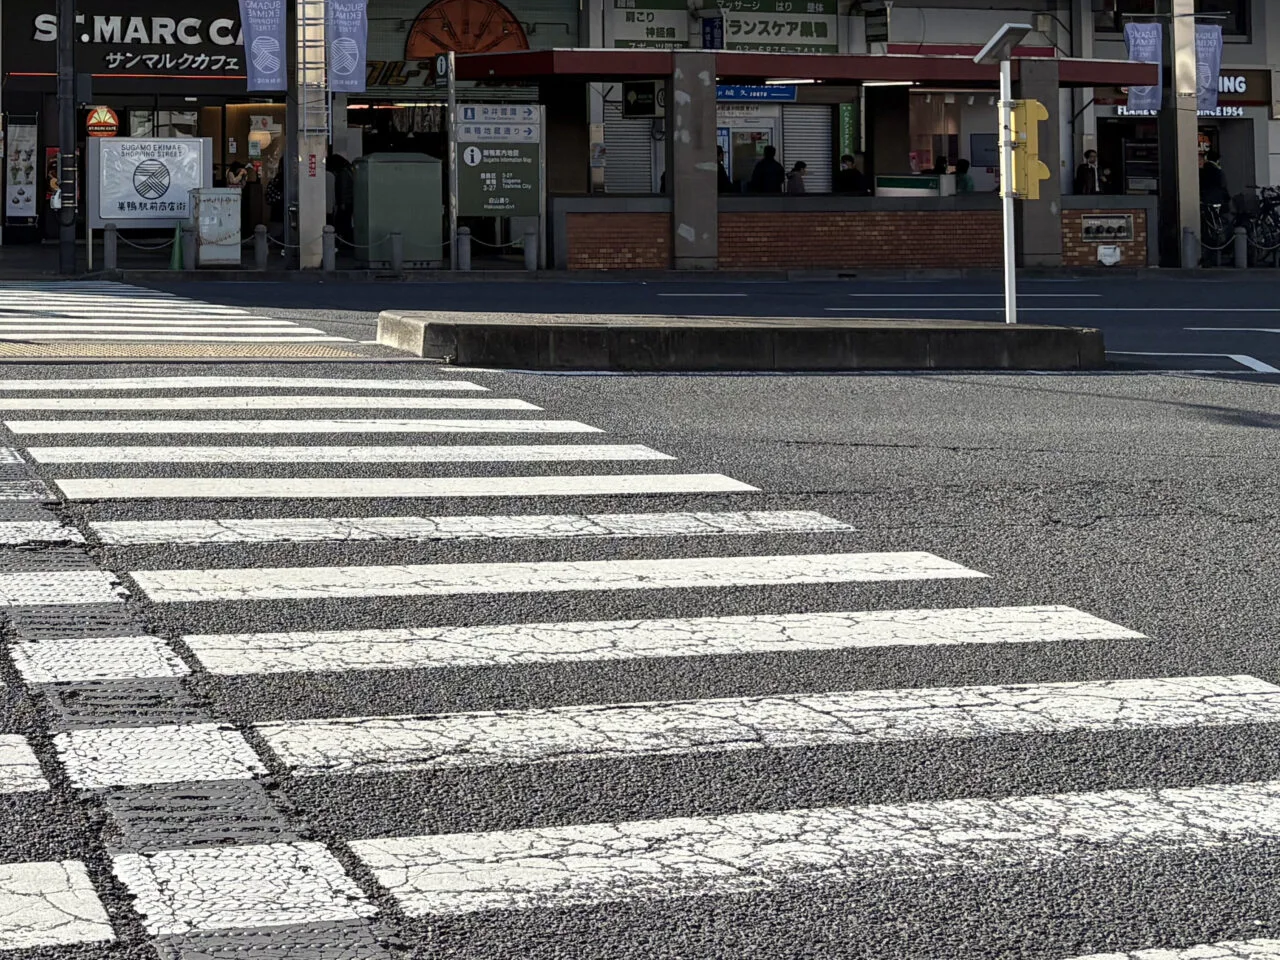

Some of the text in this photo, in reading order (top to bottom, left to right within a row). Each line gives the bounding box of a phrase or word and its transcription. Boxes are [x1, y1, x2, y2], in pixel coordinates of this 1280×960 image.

[716, 0, 761, 10] マッサージ
[775, 1, 793, 12] はり
[625, 11, 655, 23] 肩こり
[646, 27, 677, 39] 神経痛
[726, 19, 828, 38] ランスケア巣鴨
[1222, 106, 1244, 116] 1954
[120, 144, 152, 152] SUGAMO
[117, 200, 187, 212] 巣鴨駅前商店街
